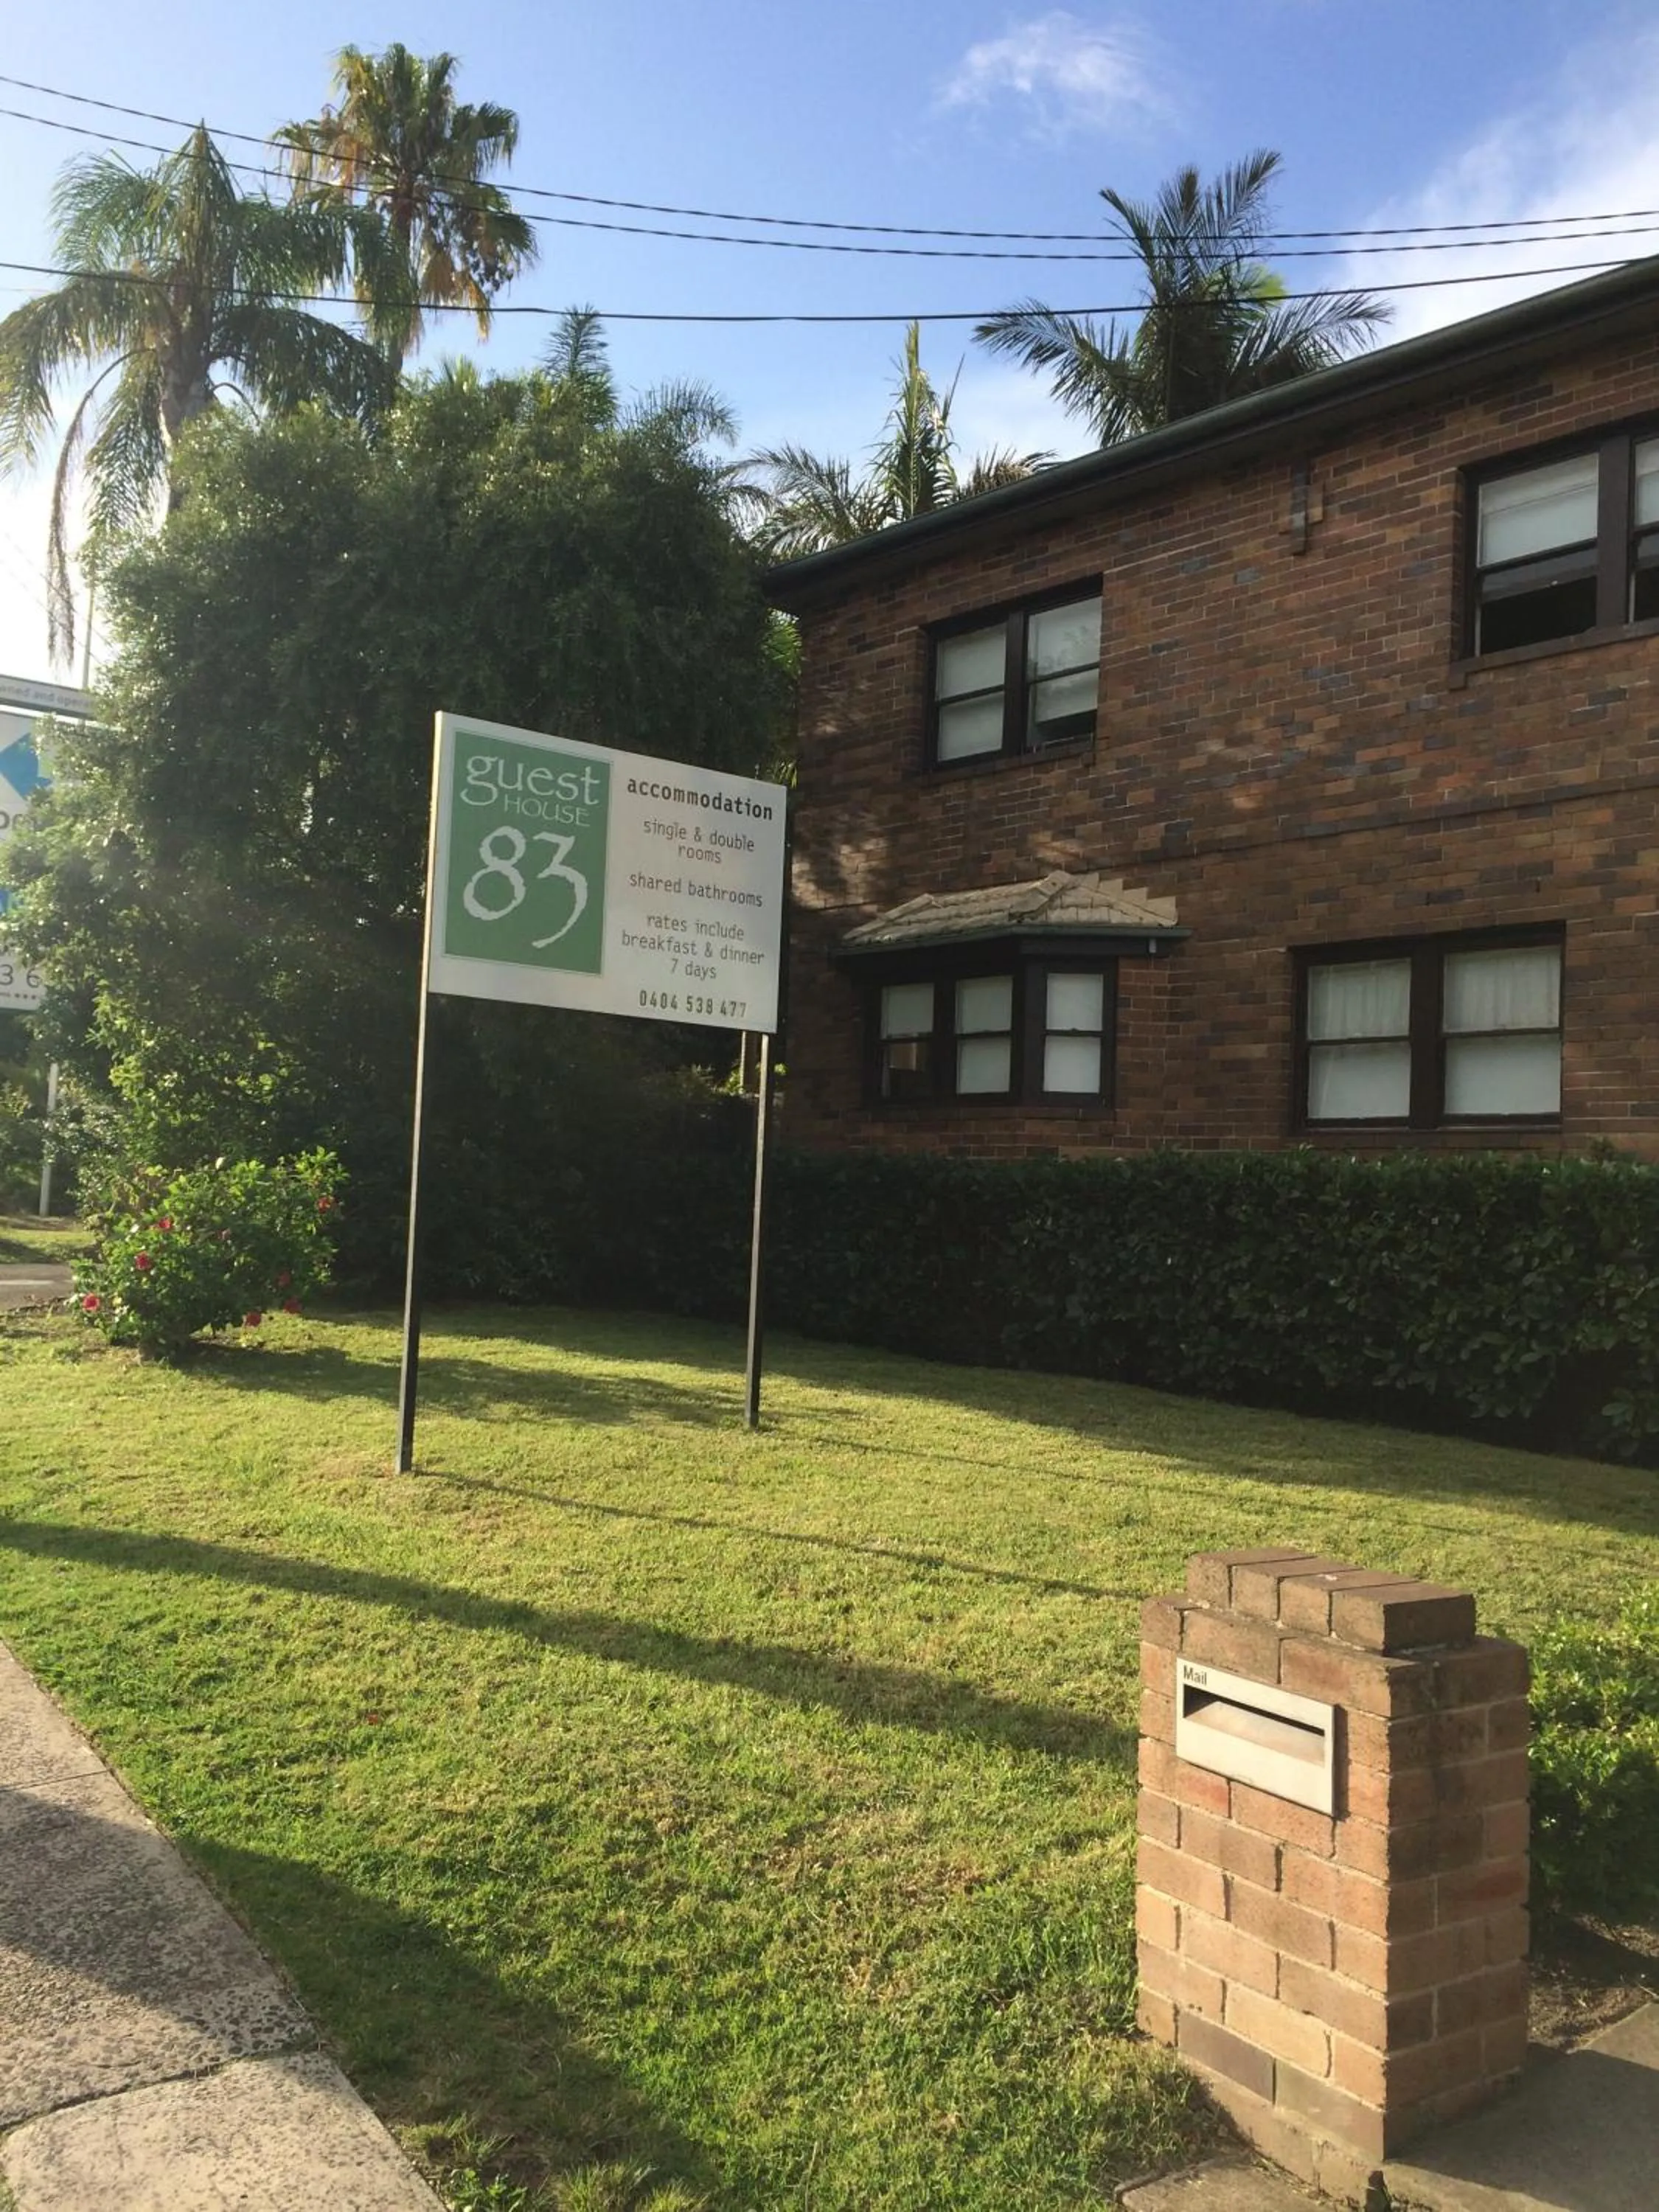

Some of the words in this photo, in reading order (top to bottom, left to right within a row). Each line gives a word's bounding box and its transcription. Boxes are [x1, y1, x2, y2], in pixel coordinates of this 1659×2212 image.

[460, 755, 600, 806] guest
[504, 793, 590, 827] HOUSE
[627, 778, 773, 821] accommodation
[644, 818, 686, 840] single
[694, 827, 702, 842] &
[709, 830, 754, 852] double
[678, 845, 721, 863] rooms
[463, 825, 588, 948] 83
[630, 872, 681, 894] shared
[688, 880, 762, 908] bathrooms
[647, 914, 687, 933] rates
[696, 919, 744, 941] include
[622, 930, 697, 956] breakfast
[704, 942, 712, 958] &
[720, 945, 764, 964] dinner
[671, 959, 678, 973] 7
[685, 961, 717, 981] days
[639, 990, 678, 1010] 0404
[686, 995, 713, 1015] 538
[720, 1001, 747, 1018] 477
[1183, 1664, 1207, 1686] Mail
